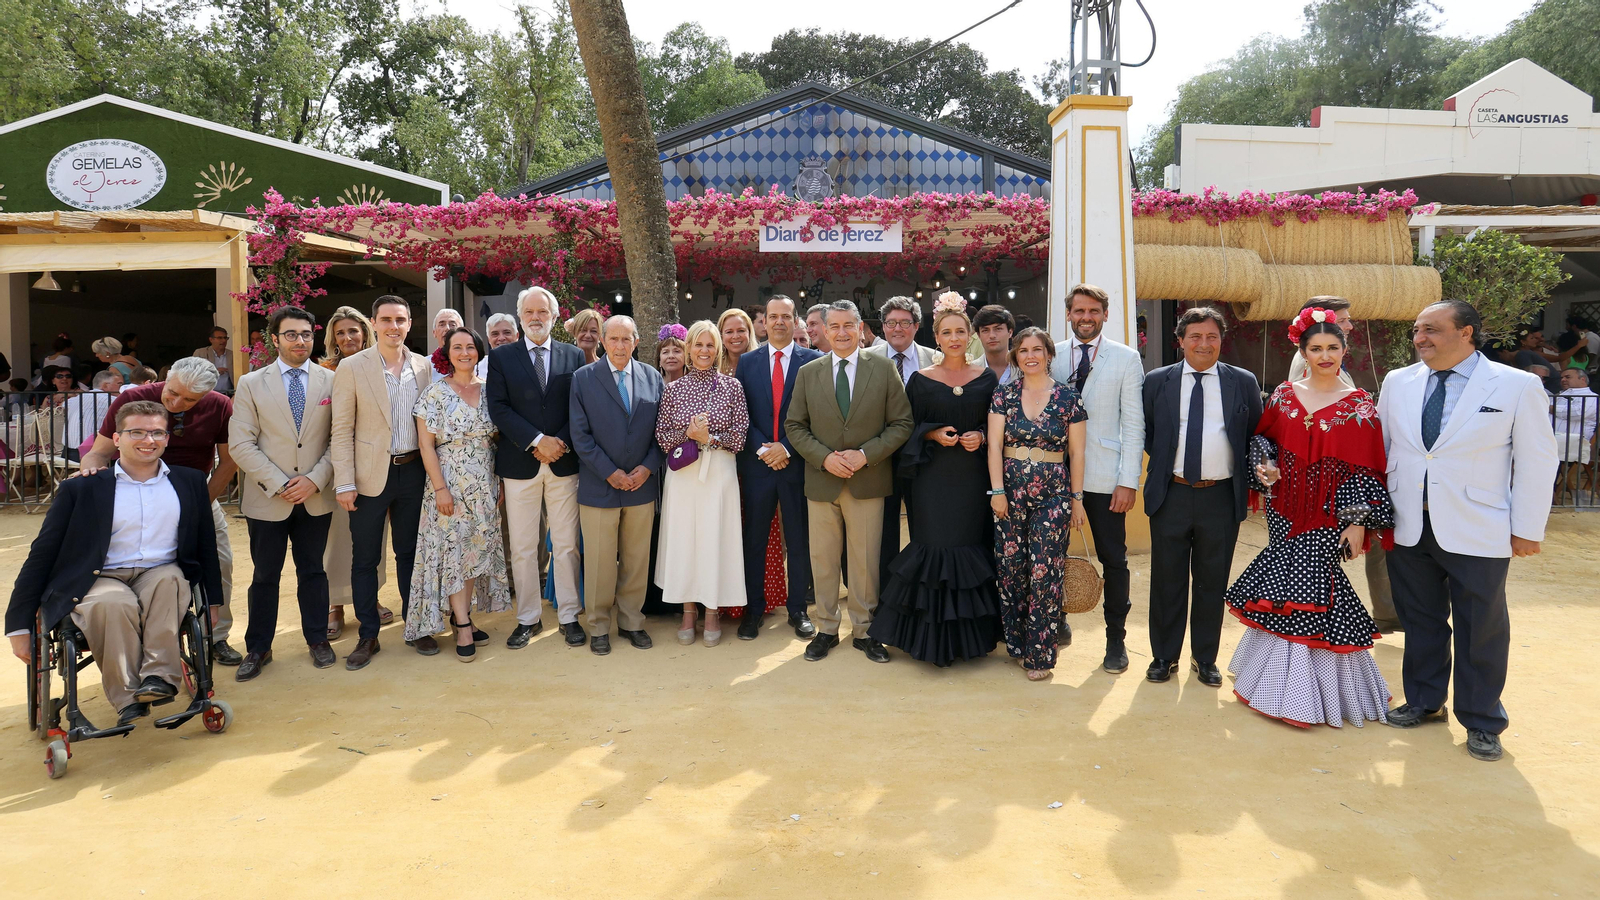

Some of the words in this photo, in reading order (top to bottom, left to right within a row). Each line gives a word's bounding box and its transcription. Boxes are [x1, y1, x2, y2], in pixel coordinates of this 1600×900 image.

[72, 157, 142, 170] GEMELAS
[86, 170, 142, 193] Jerez
[818, 226, 839, 241] de
